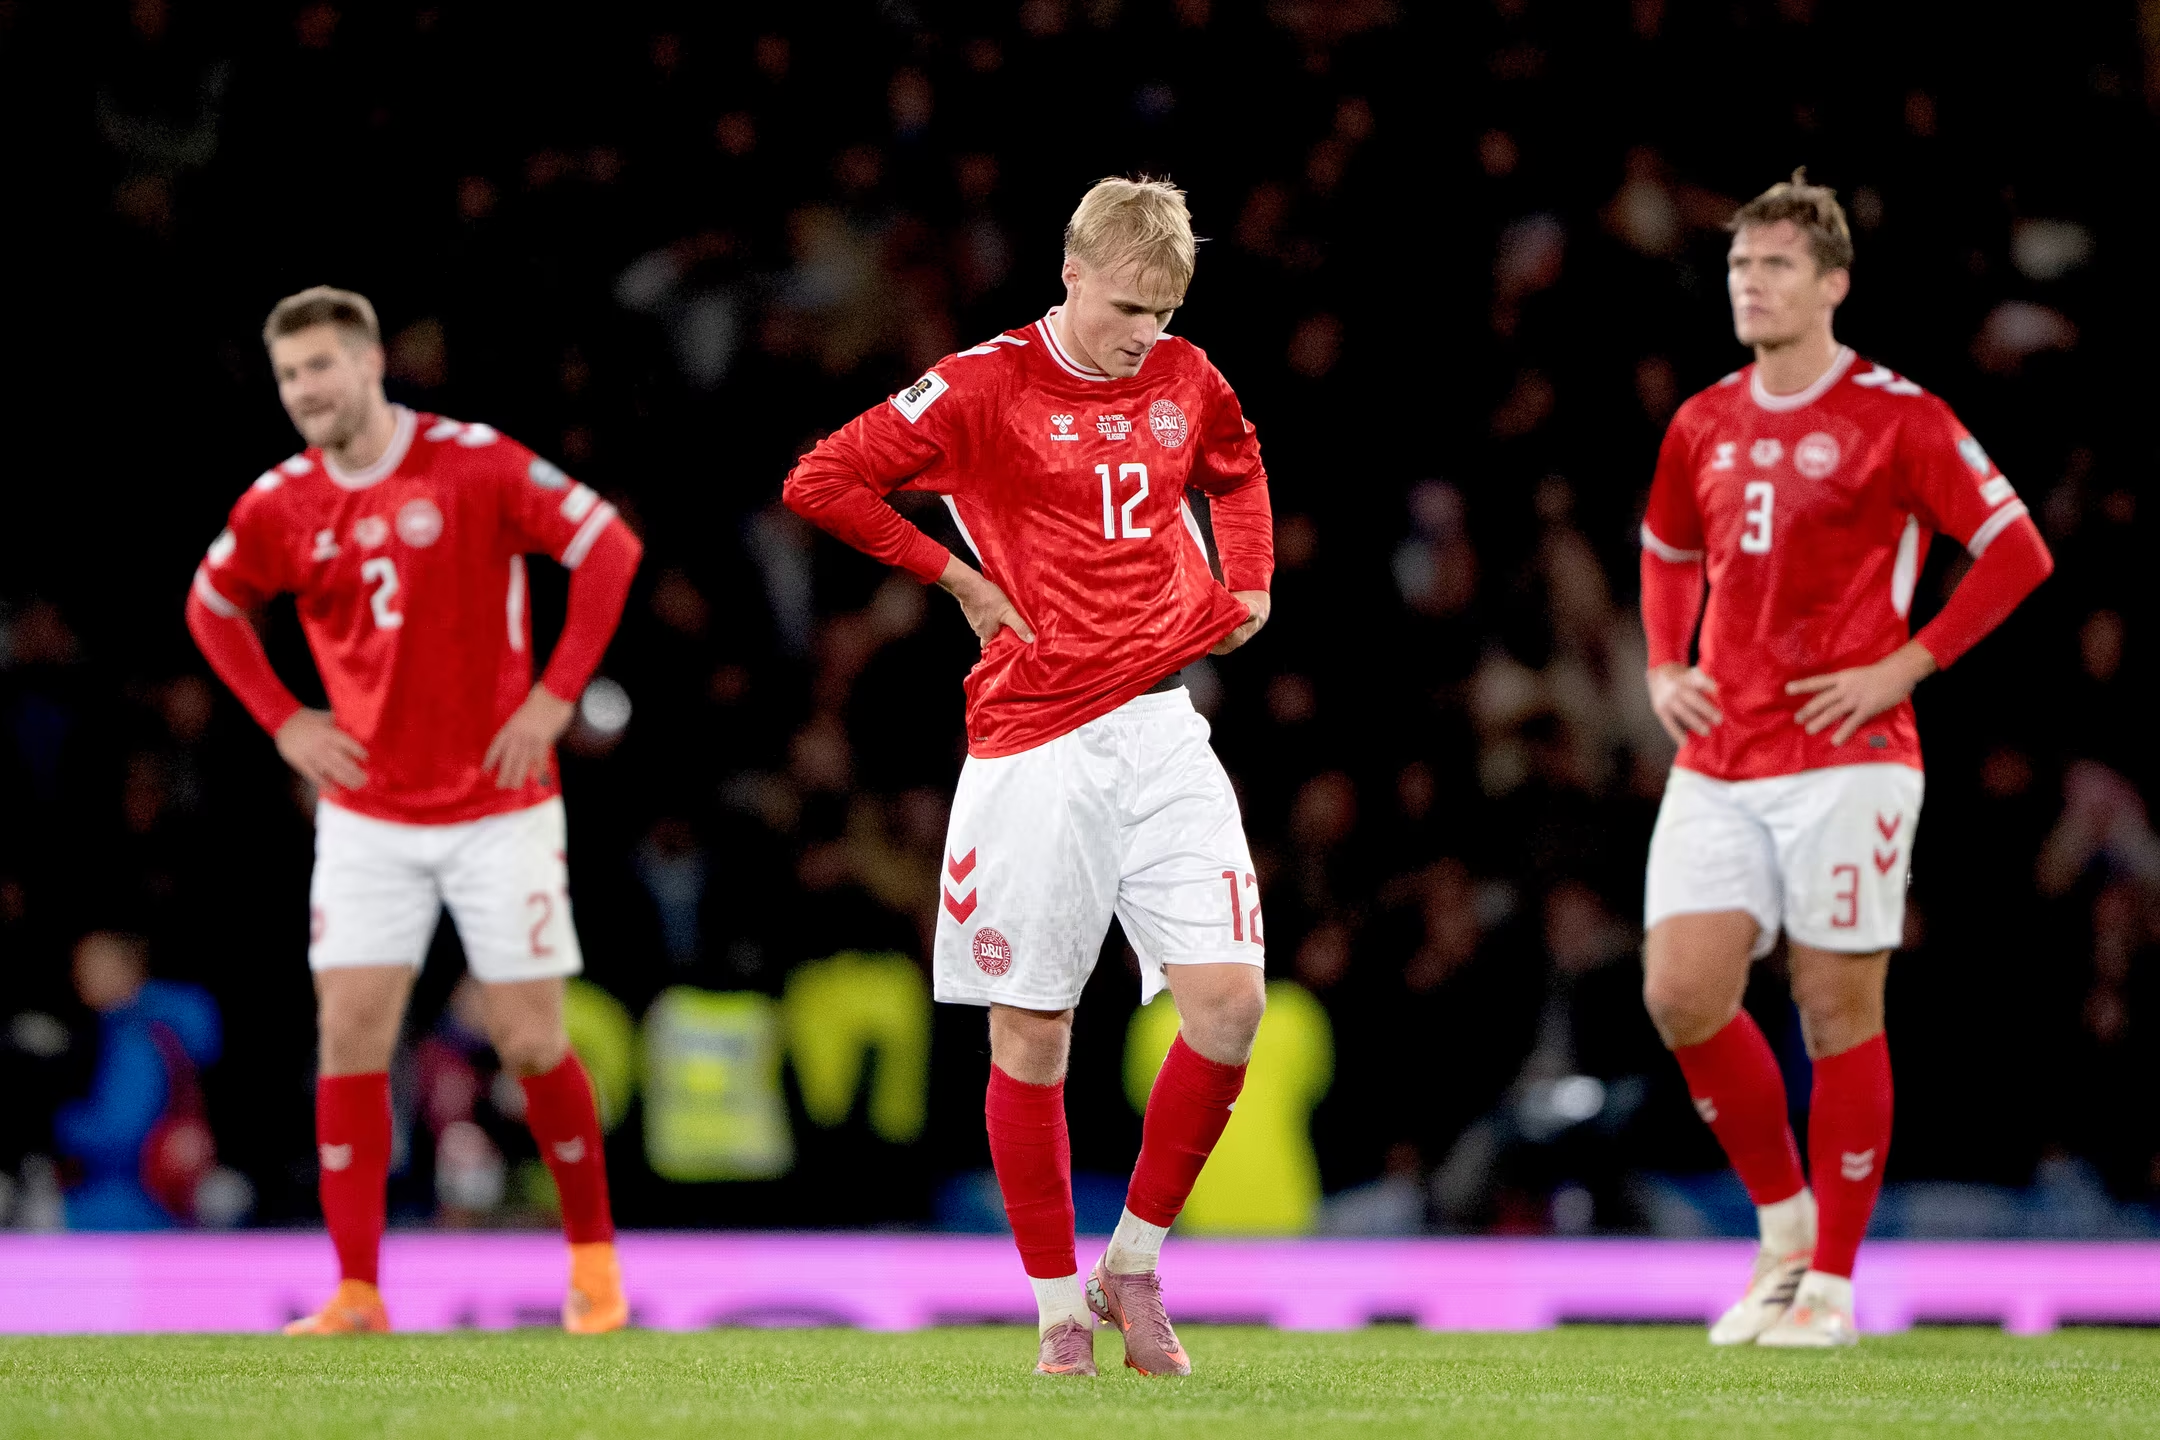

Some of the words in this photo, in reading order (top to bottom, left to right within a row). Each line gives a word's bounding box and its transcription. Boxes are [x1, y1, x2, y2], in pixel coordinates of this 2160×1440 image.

[1050, 432, 1079, 441] hummel
[1096, 422, 1112, 433] SCO
[1154, 415, 1179, 430] DBU
[1094, 463, 1151, 539] 12
[1740, 480, 1775, 552] 3
[361, 557, 403, 629] 2
[526, 891, 555, 959] 2
[1222, 871, 1264, 948] 12
[1831, 864, 1860, 929] 3
[980, 943, 1004, 959] DBU
